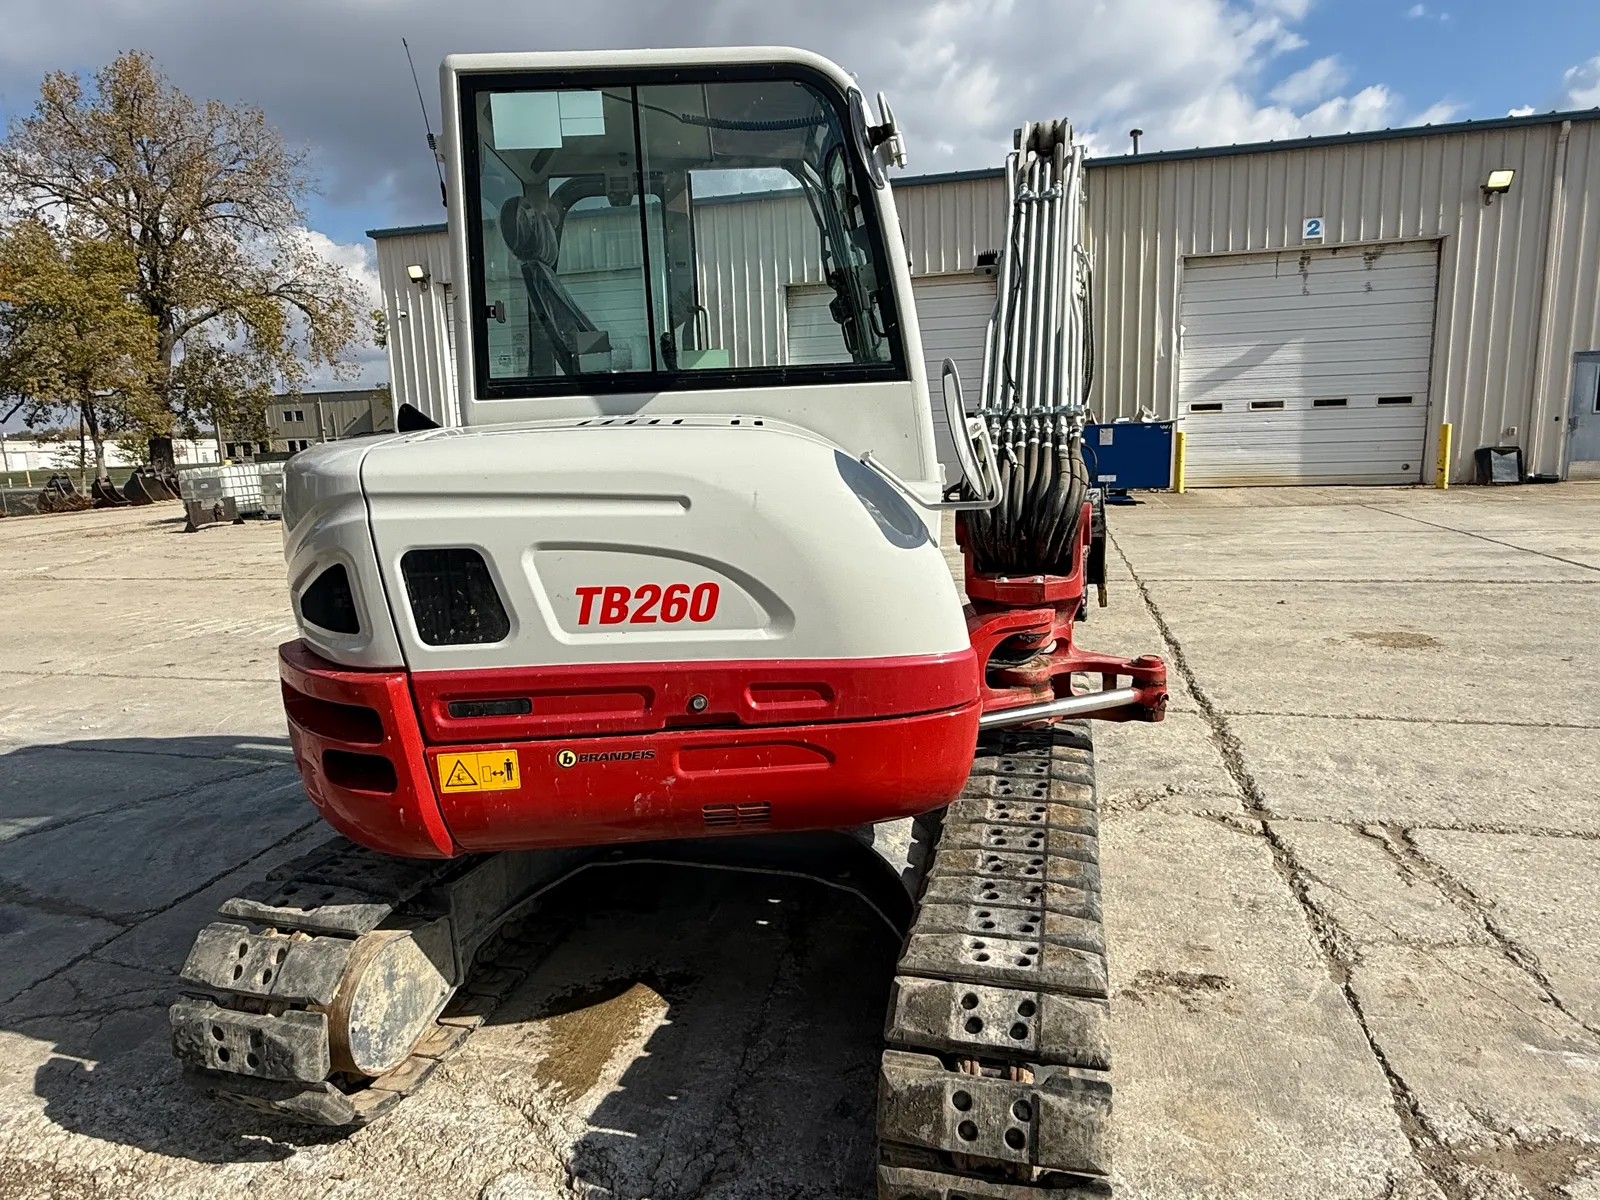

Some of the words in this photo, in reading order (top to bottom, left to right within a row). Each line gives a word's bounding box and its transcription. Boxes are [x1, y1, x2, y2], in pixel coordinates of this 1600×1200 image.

[1306, 219, 1321, 236] 2
[575, 582, 720, 625] TB260
[578, 750, 655, 763] BRANDEIS
